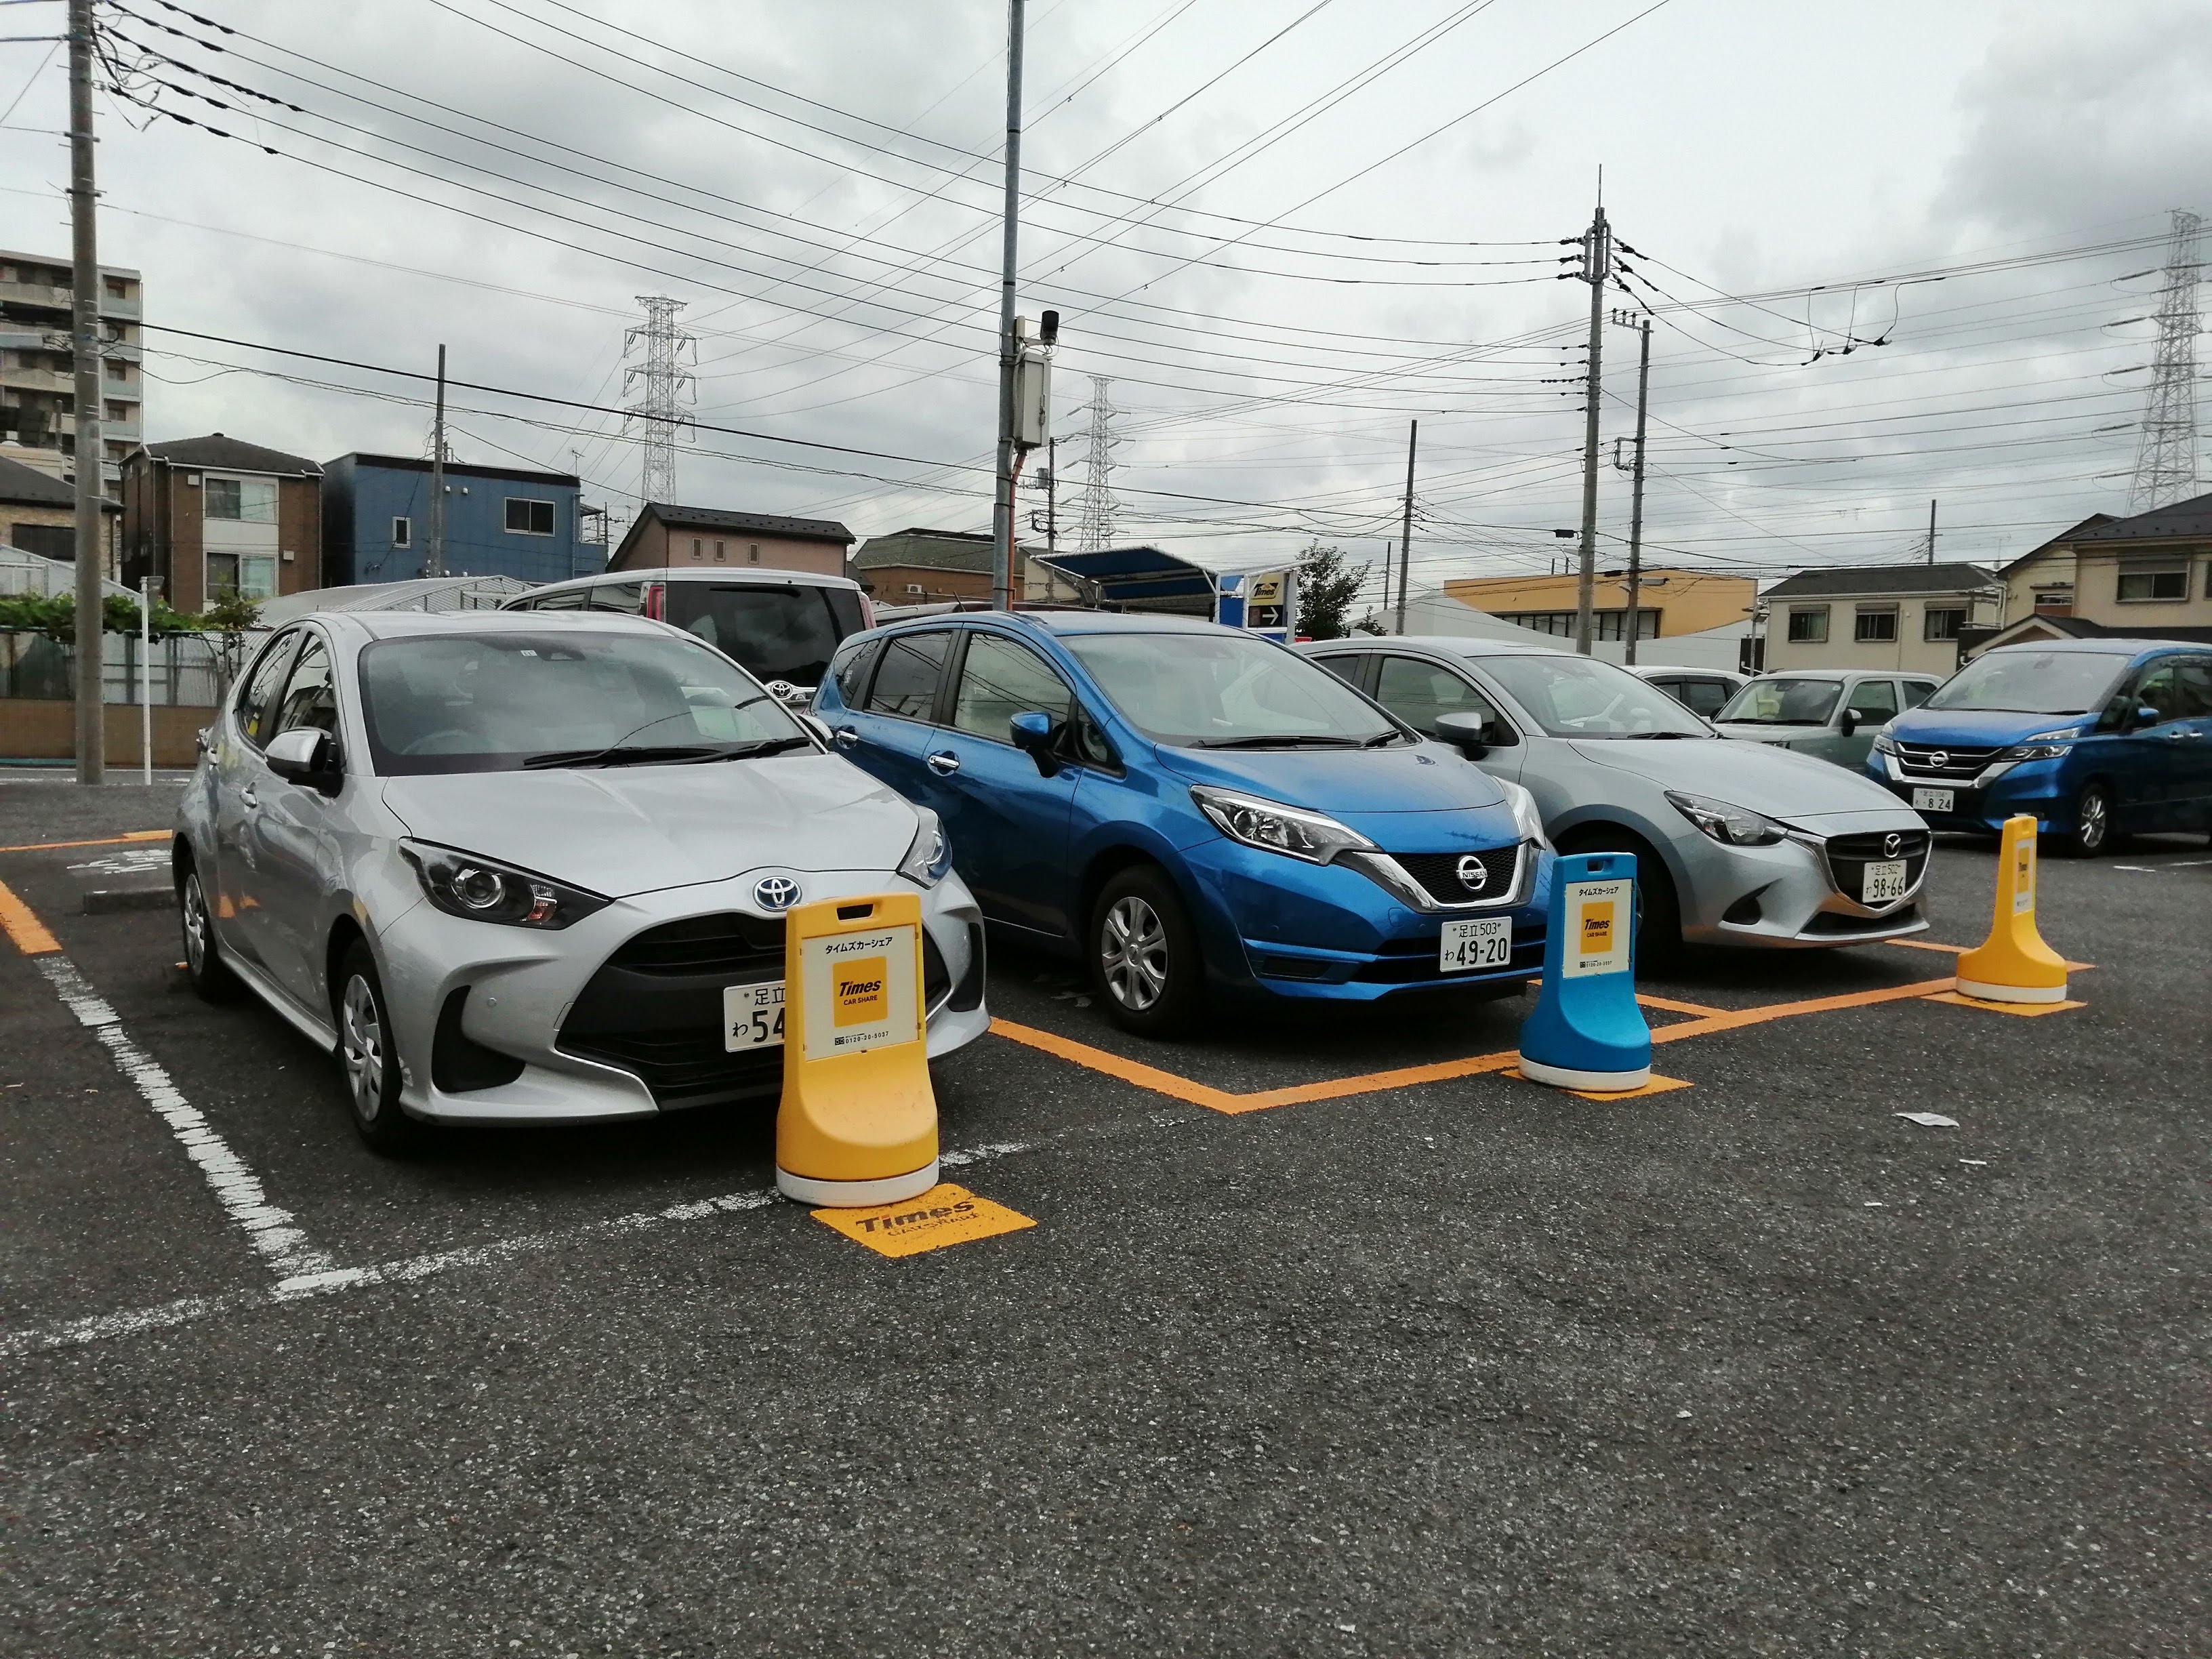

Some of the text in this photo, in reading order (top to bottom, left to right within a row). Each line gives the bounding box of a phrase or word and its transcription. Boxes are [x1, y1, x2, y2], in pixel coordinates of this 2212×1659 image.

[1254, 586, 1275, 597] Times
[1462, 869, 1488, 878] NISSAN
[1578, 886, 1619, 897] タイムズカーシェア
[1584, 918, 1610, 930] Times
[825, 936, 893, 955] タイムズカーシェア
[1456, 937, 1507, 966] 49-20
[839, 980, 882, 997] Times
[754, 987, 785, 1006] 足立
[844, 995, 878, 1006] CAR SHARE
[732, 1022, 749, 1038] わ
[845, 1031, 889, 1044] 0120-20-5037
[855, 1201, 975, 1233] Times
